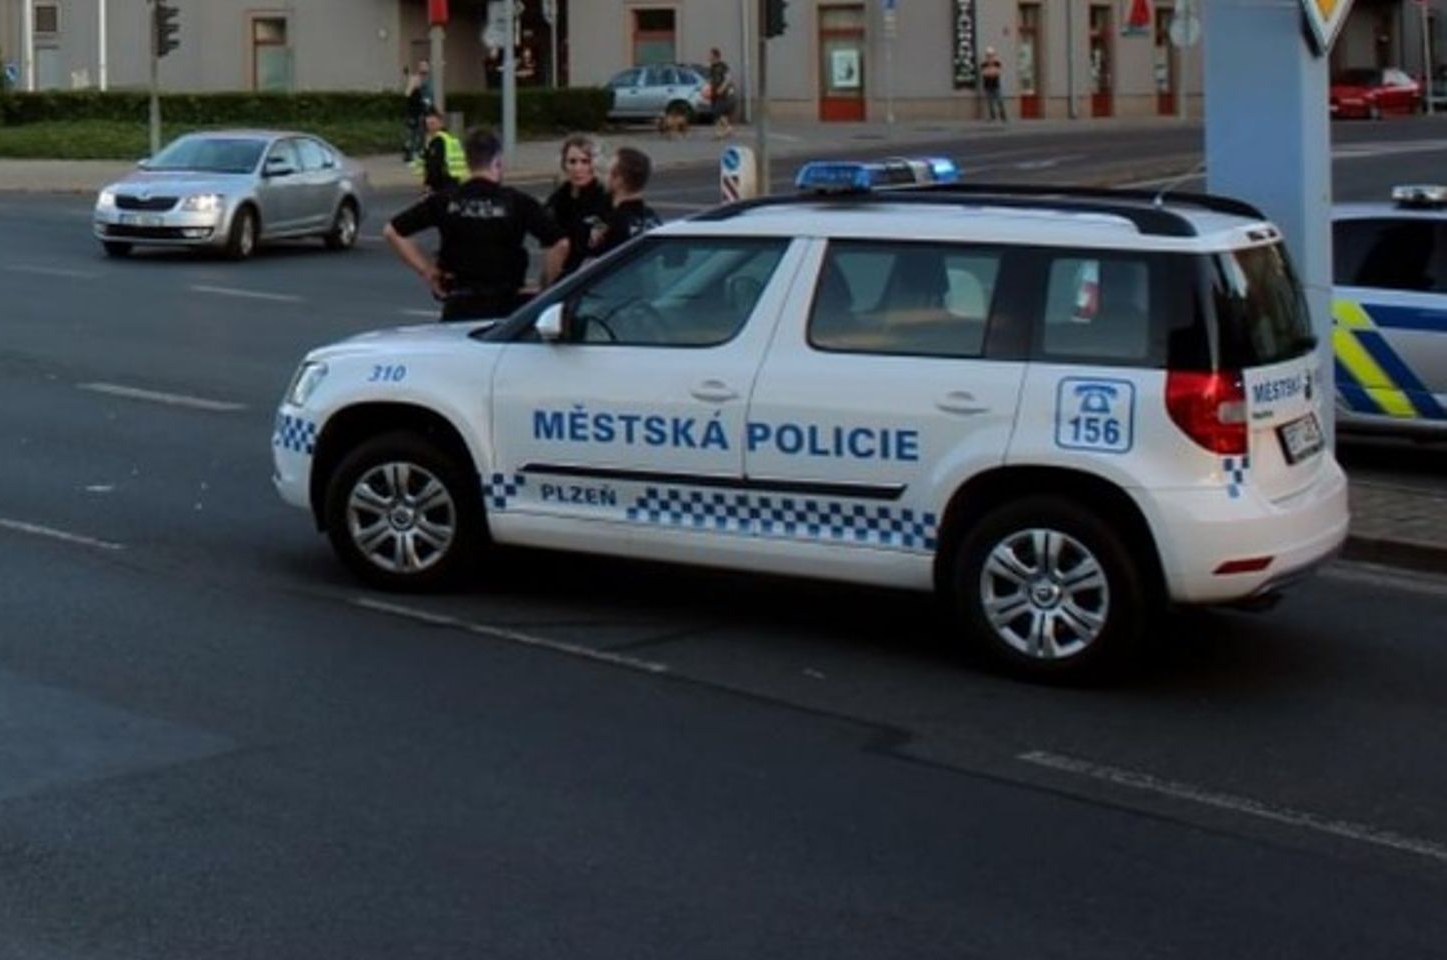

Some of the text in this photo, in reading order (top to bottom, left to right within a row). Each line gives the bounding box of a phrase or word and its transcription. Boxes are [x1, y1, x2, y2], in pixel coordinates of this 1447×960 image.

[368, 365, 407, 382] 310
[533, 404, 920, 461] MĚSTSKÁ POLICIE
[1069, 416, 1120, 445] 156
[540, 482, 617, 506] PLZEŇ
